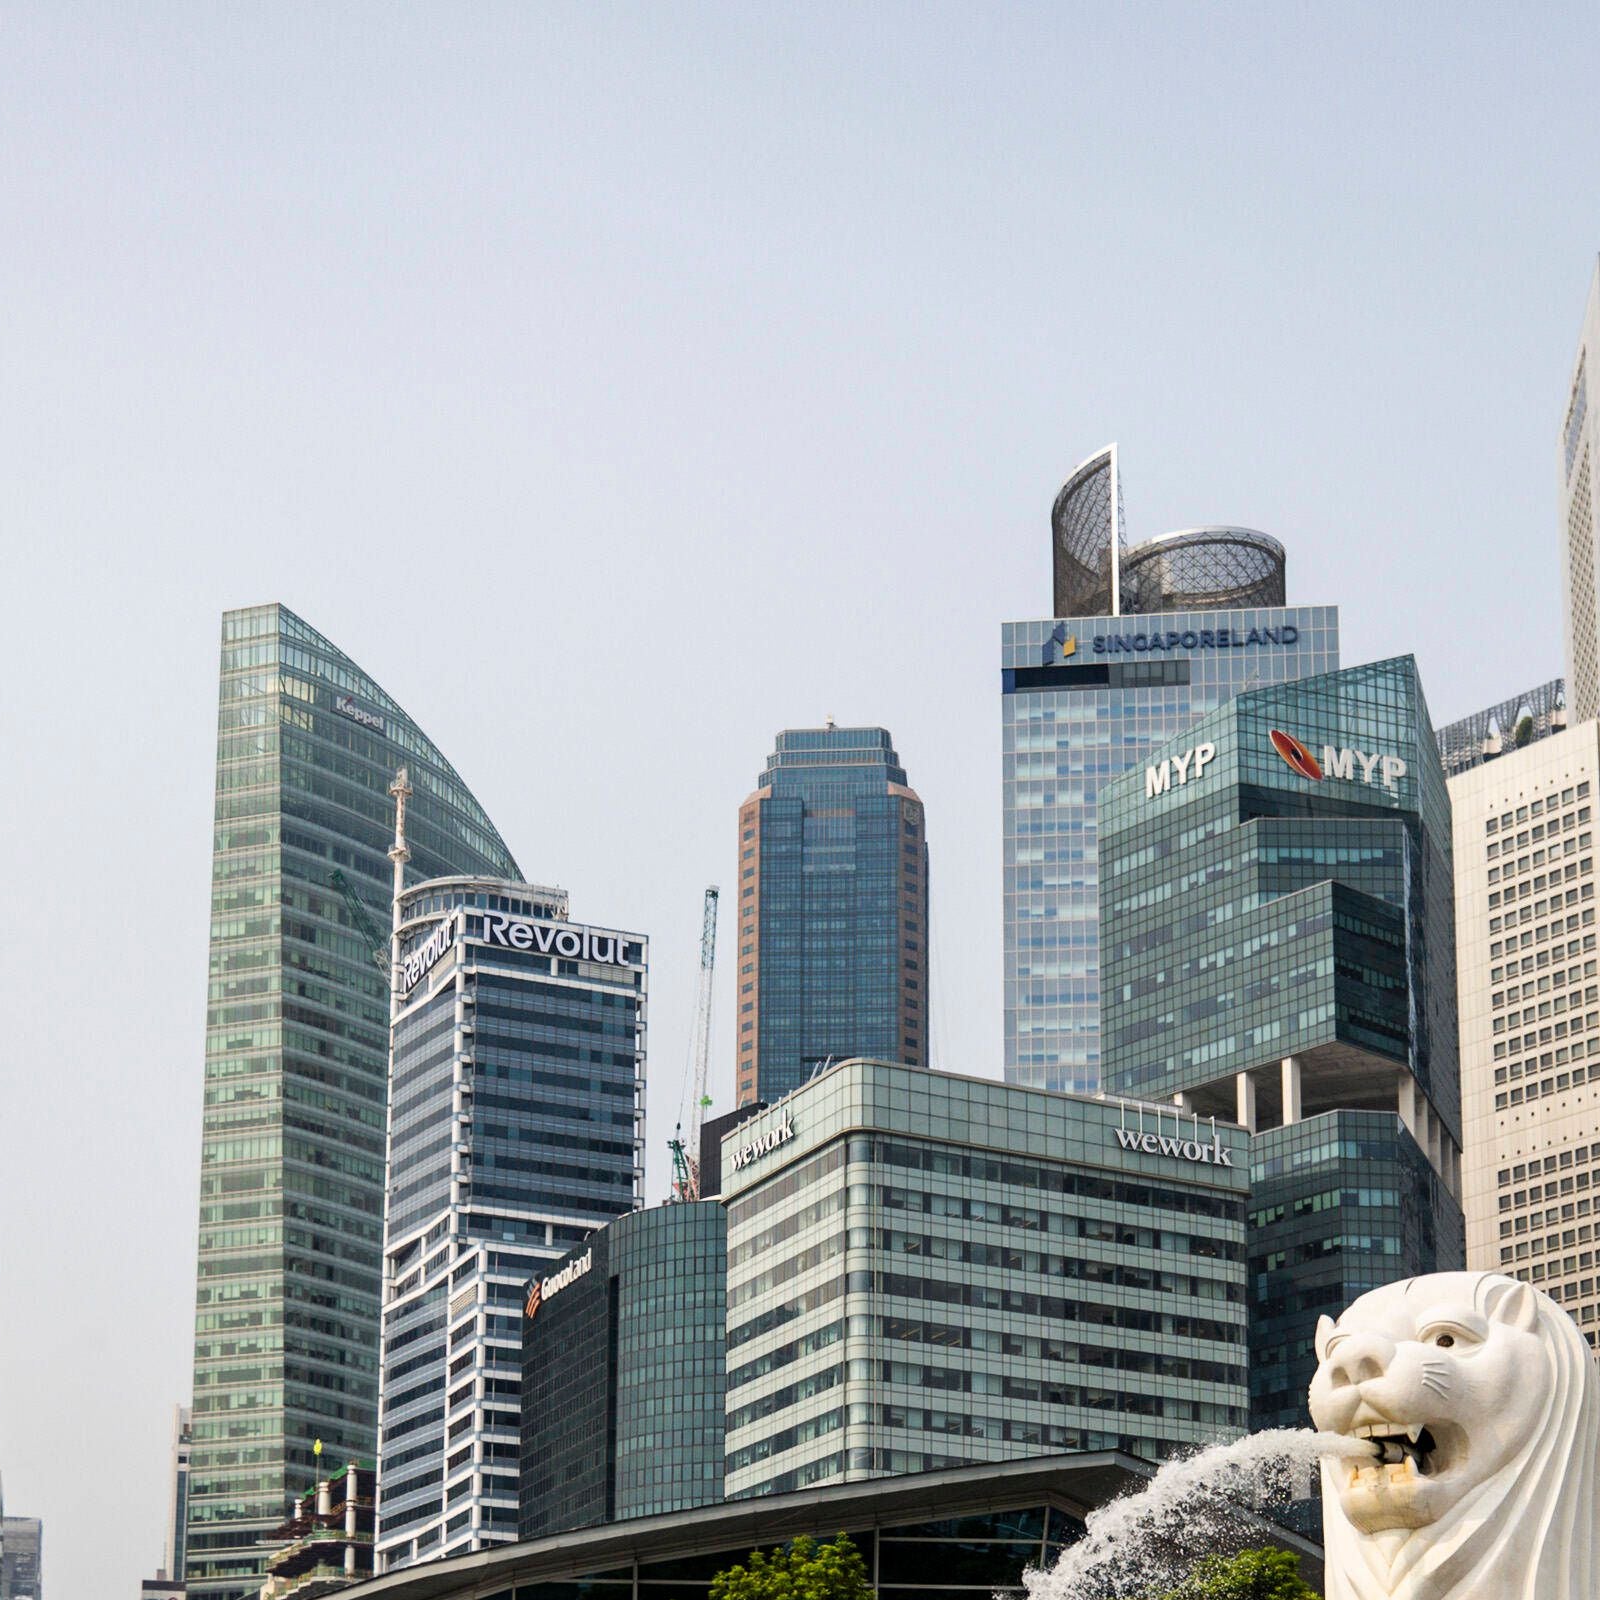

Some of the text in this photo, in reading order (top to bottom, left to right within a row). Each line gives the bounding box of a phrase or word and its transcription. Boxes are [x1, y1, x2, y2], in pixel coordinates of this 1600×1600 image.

[1092, 625, 1299, 655] SINGAPORELAND
[336, 695, 384, 730] Keppel
[1145, 742, 1216, 799] MYP
[1323, 745, 1408, 788] MYP
[403, 918, 453, 994] Revolut
[483, 911, 630, 967] Revolut
[730, 1109, 795, 1172] wework
[1114, 1128, 1234, 1166] wework
